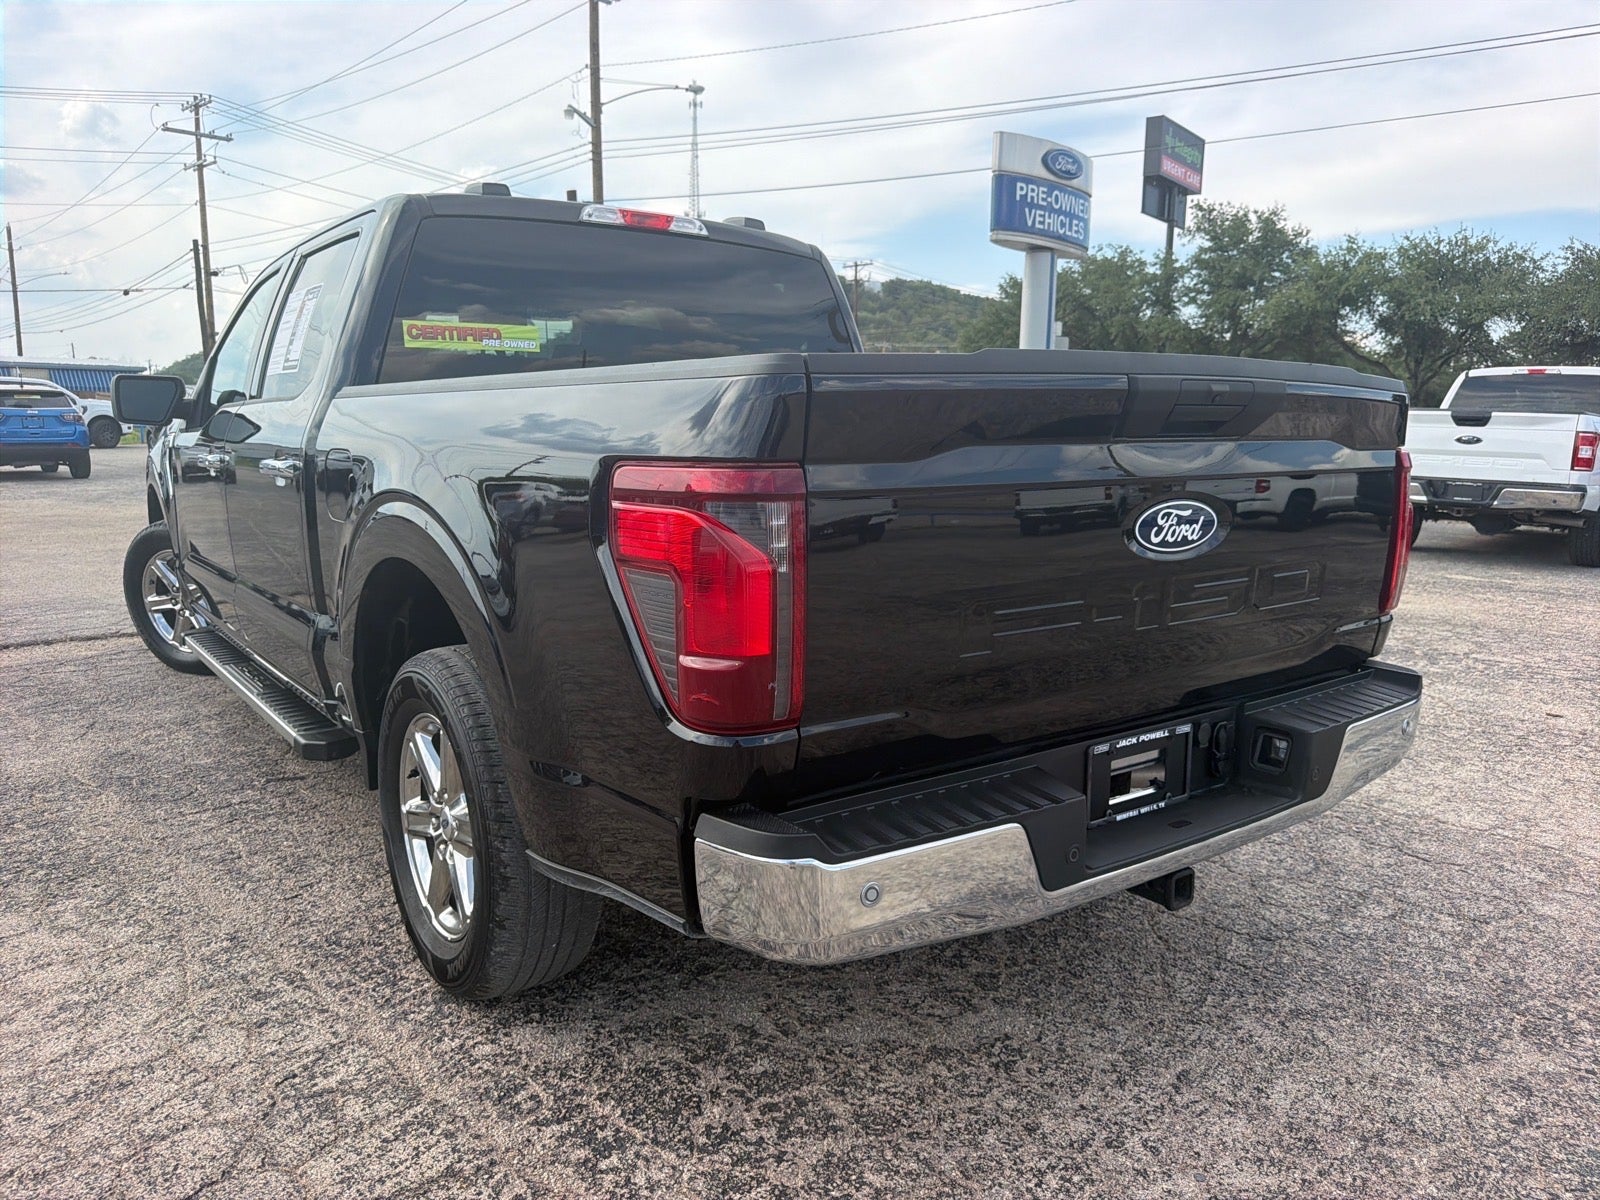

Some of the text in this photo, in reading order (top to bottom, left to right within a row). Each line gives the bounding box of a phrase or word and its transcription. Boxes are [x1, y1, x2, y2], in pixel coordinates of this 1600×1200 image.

[1055, 155, 1078, 173] Ford
[1163, 159, 1201, 186] URGENT CARE
[1016, 182, 1089, 219] PRE-OWNED
[1025, 208, 1085, 240] VEHICLES
[406, 323, 502, 342] CERTIFIED
[482, 338, 536, 349] PRE-OWNED
[1150, 507, 1204, 545] Ford
[640, 588, 674, 601] FORD
[959, 560, 1326, 659] F-150
[1115, 730, 1170, 748] JACK POWELL
